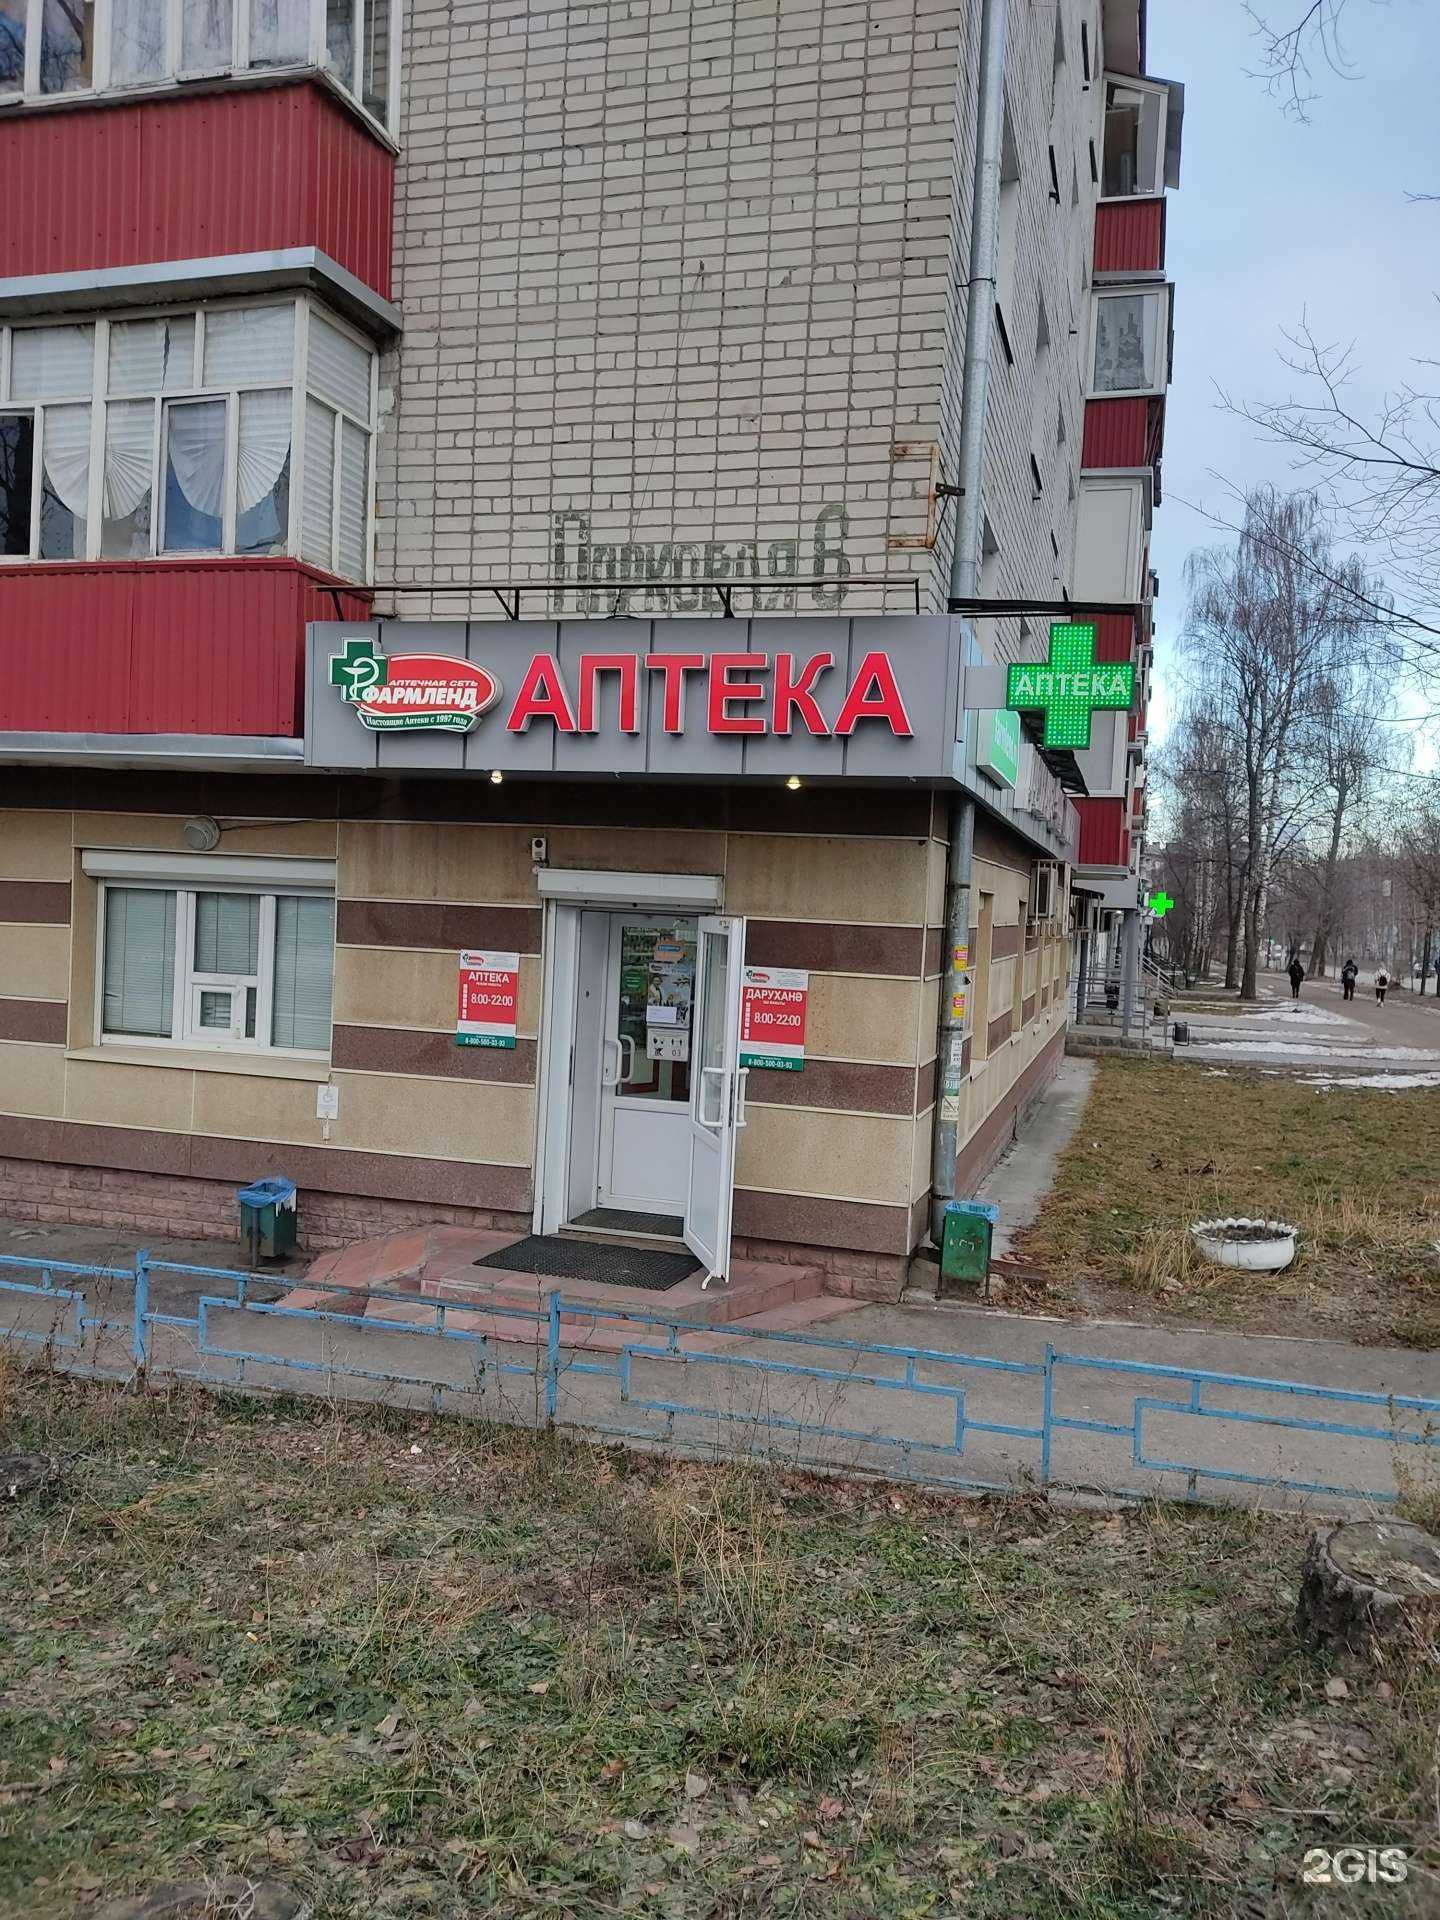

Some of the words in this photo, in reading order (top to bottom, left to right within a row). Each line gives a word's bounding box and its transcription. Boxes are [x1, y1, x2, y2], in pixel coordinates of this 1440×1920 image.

[389, 679, 447, 687] АПТЕЧНАЯ
[449, 679, 479, 687] СЕТЬ
[1014, 673, 1127, 697] АПТЕКА
[361, 686, 477, 709] ФАРМЛЕНД
[504, 651, 915, 737] АПТЕКА
[468, 971, 511, 984] АПТЕКА
[754, 1012, 801, 1027] 8:00-22:00
